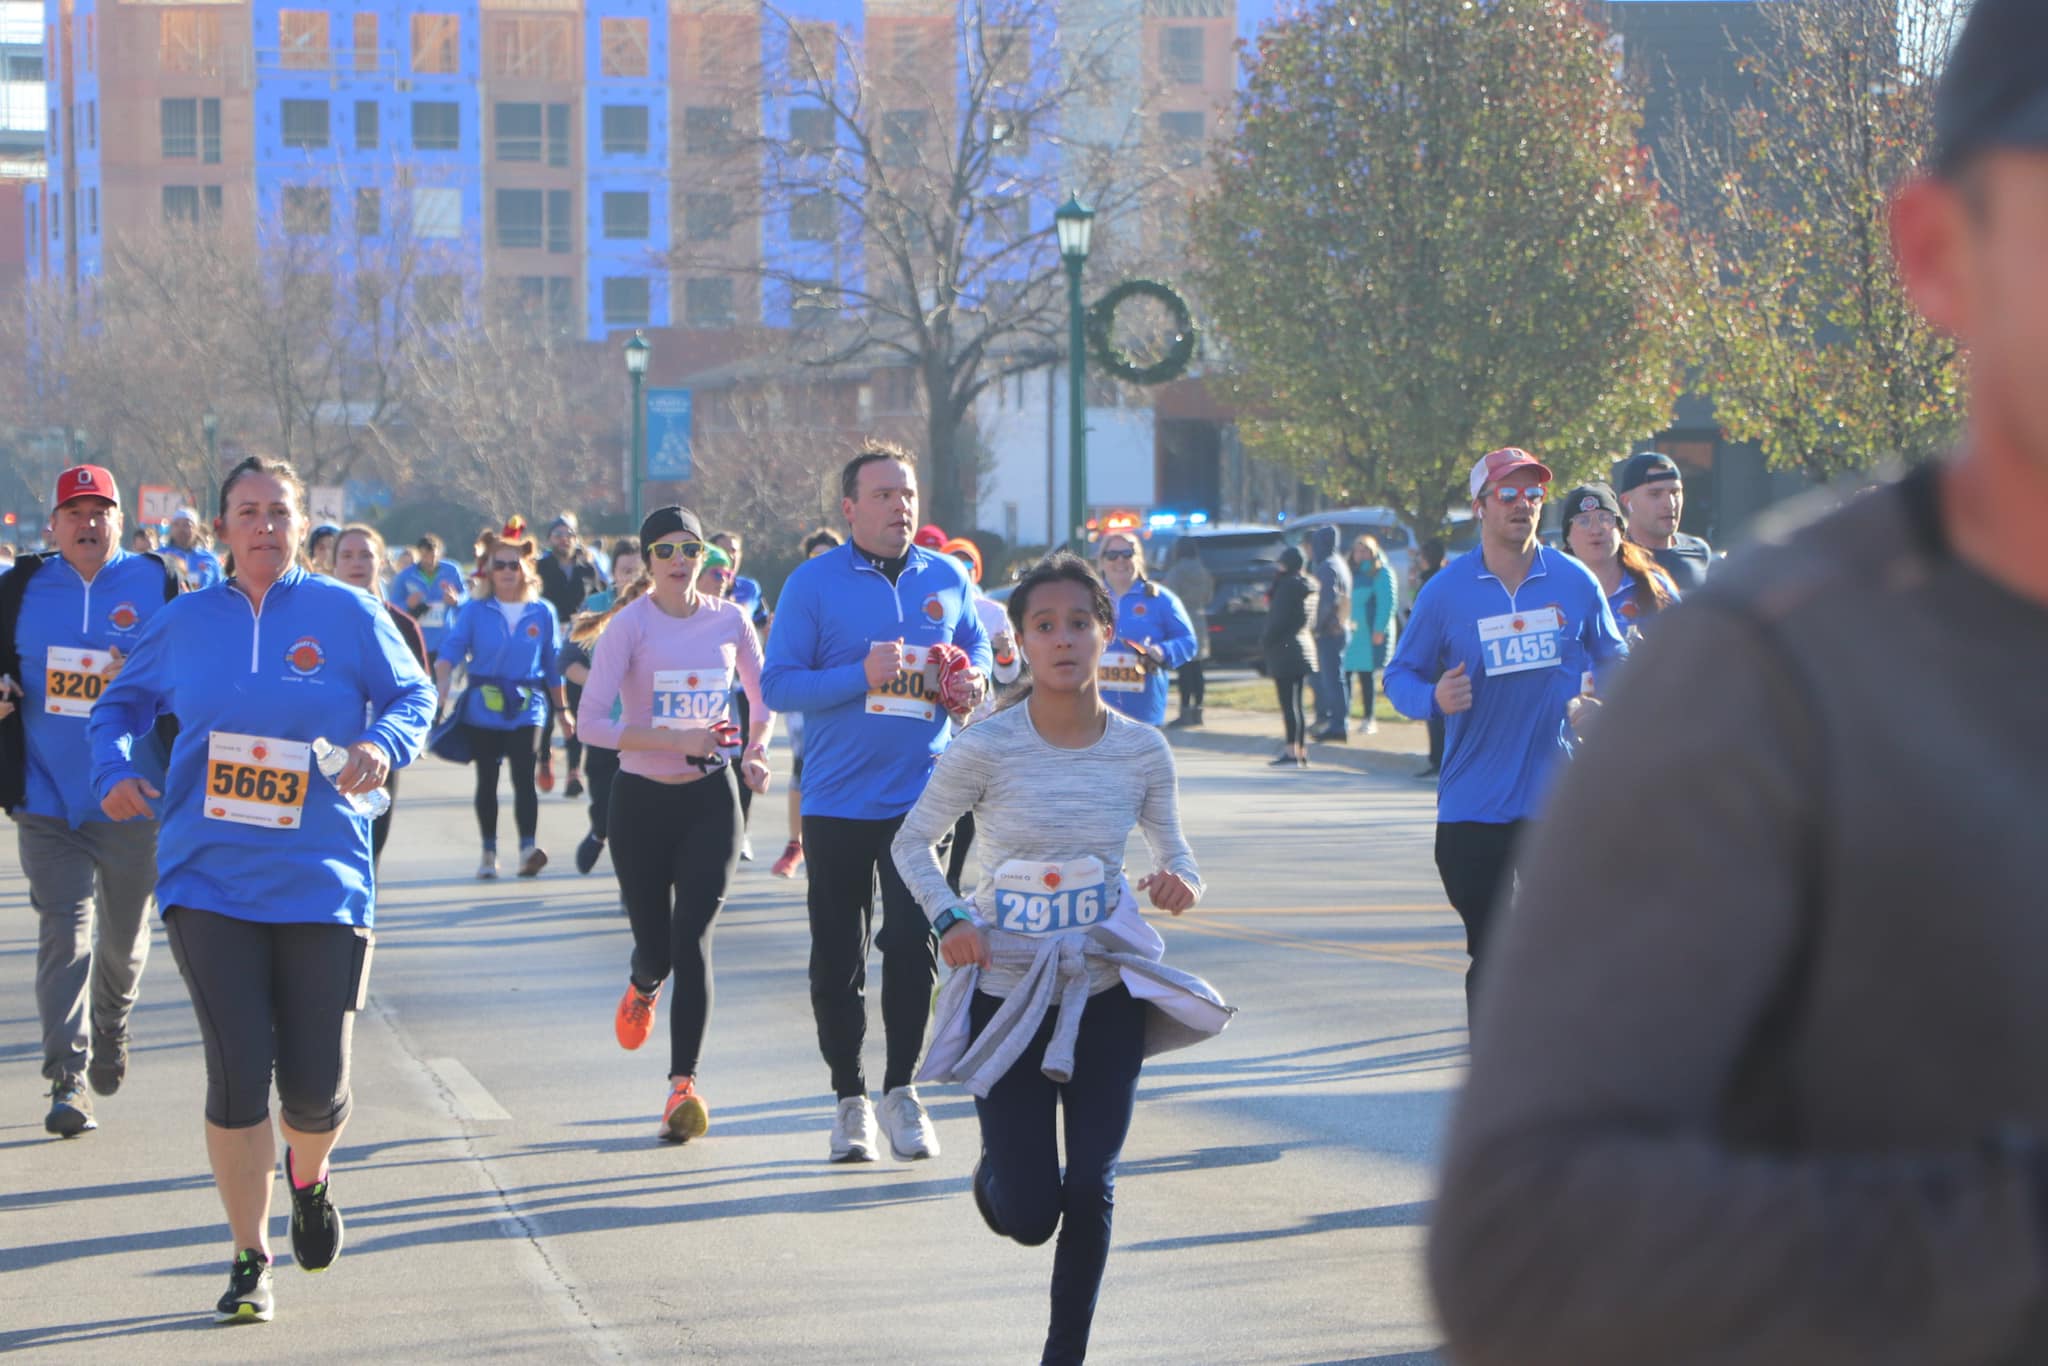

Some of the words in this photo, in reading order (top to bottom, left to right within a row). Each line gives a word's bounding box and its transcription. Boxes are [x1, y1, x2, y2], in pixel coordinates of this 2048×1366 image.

[77, 470, 92, 484] O
[1487, 632, 1556, 666] 1455
[51, 671, 110, 699] 320
[658, 691, 724, 719] 1302
[213, 763, 299, 803] 5663
[1002, 889, 1099, 931] 2916
